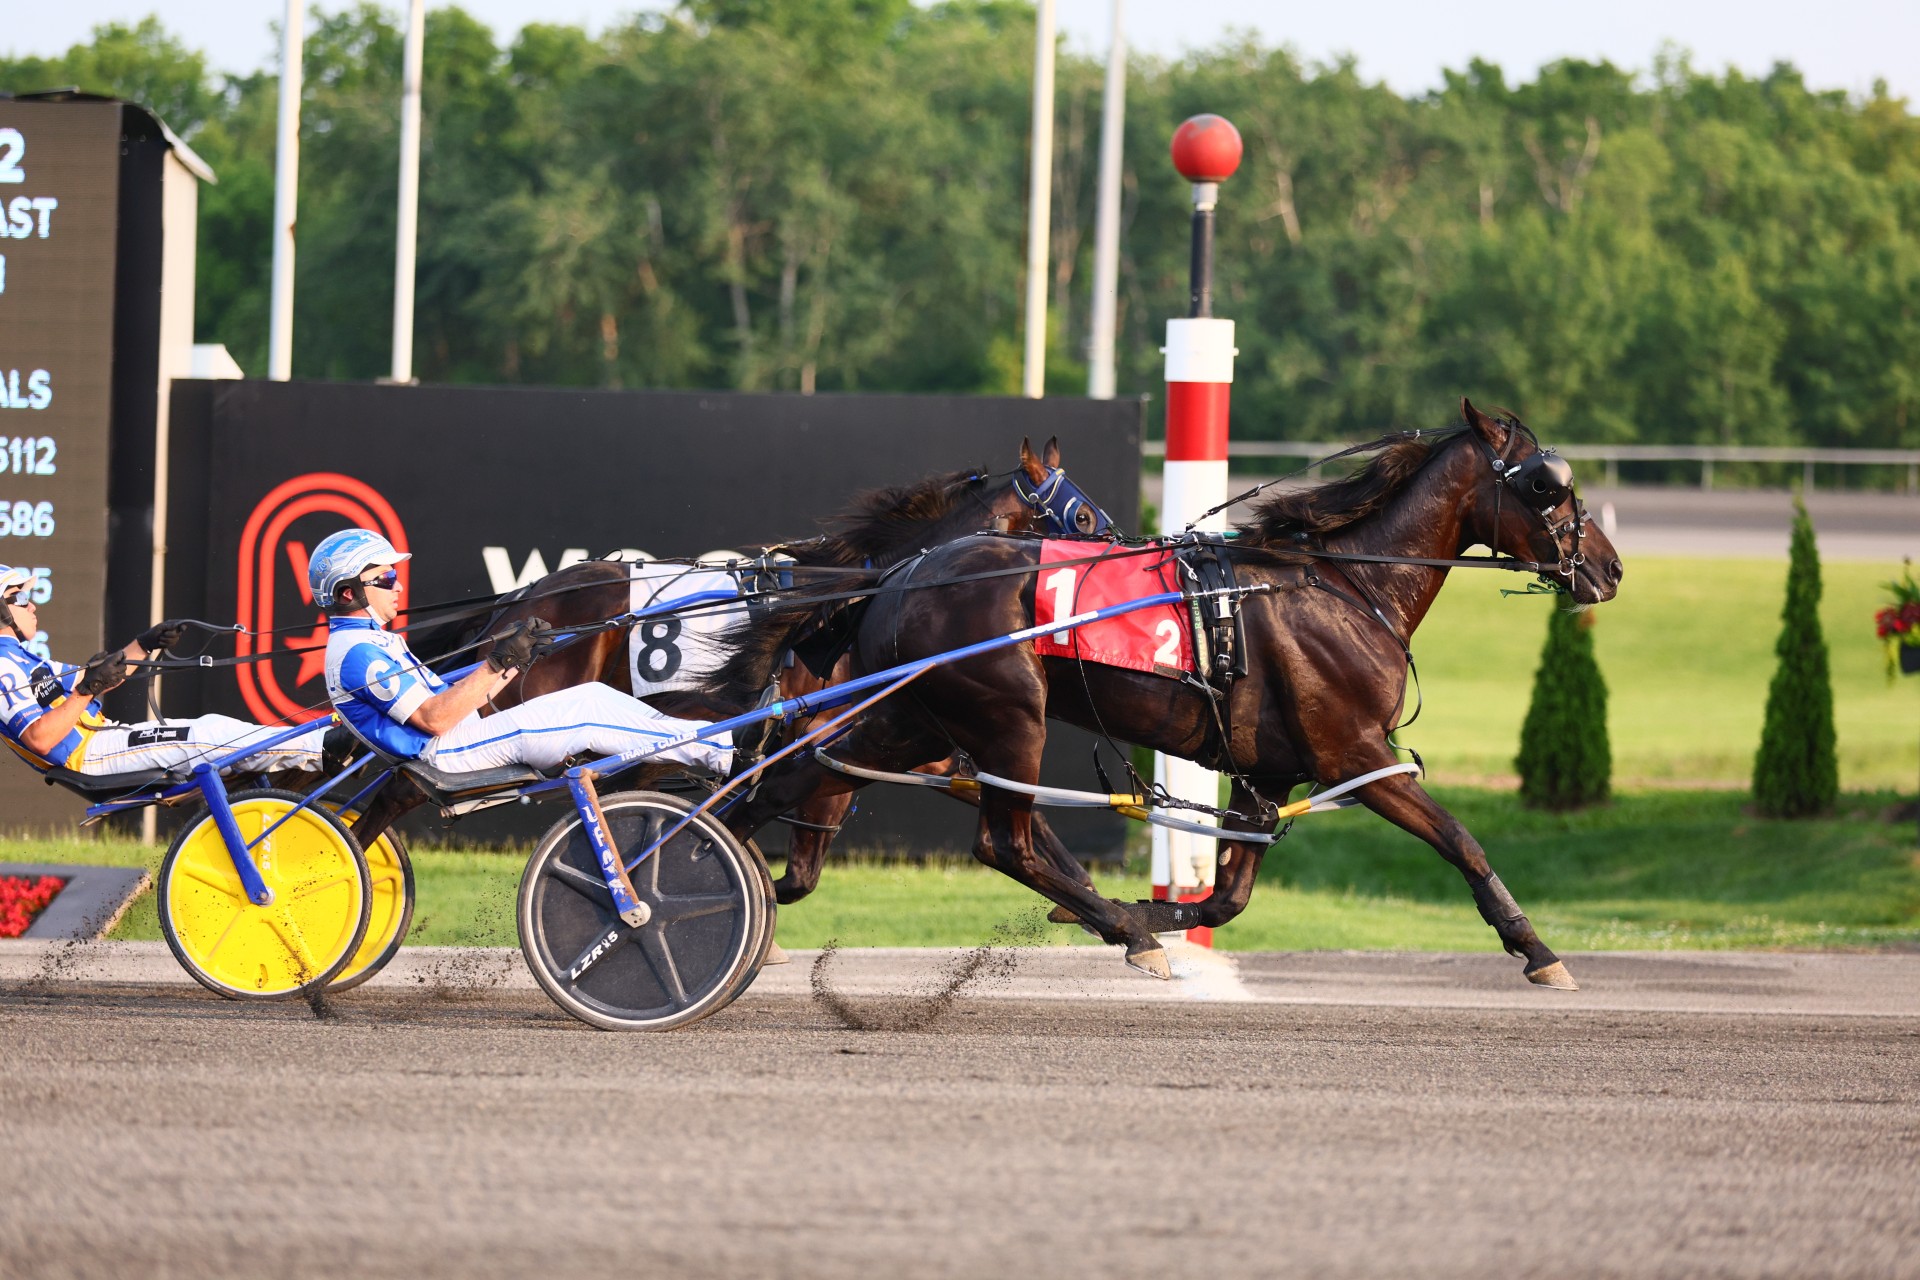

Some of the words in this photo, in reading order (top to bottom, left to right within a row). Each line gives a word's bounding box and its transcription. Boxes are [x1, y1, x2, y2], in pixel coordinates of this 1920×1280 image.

[0, 128, 25, 183] 2
[1045, 568, 1077, 646] 1
[637, 613, 682, 682] 8
[1153, 619, 1181, 666] 2
[366, 660, 400, 701] C
[618, 742, 655, 762] TRAVIS
[657, 730, 698, 750] CULLEN
